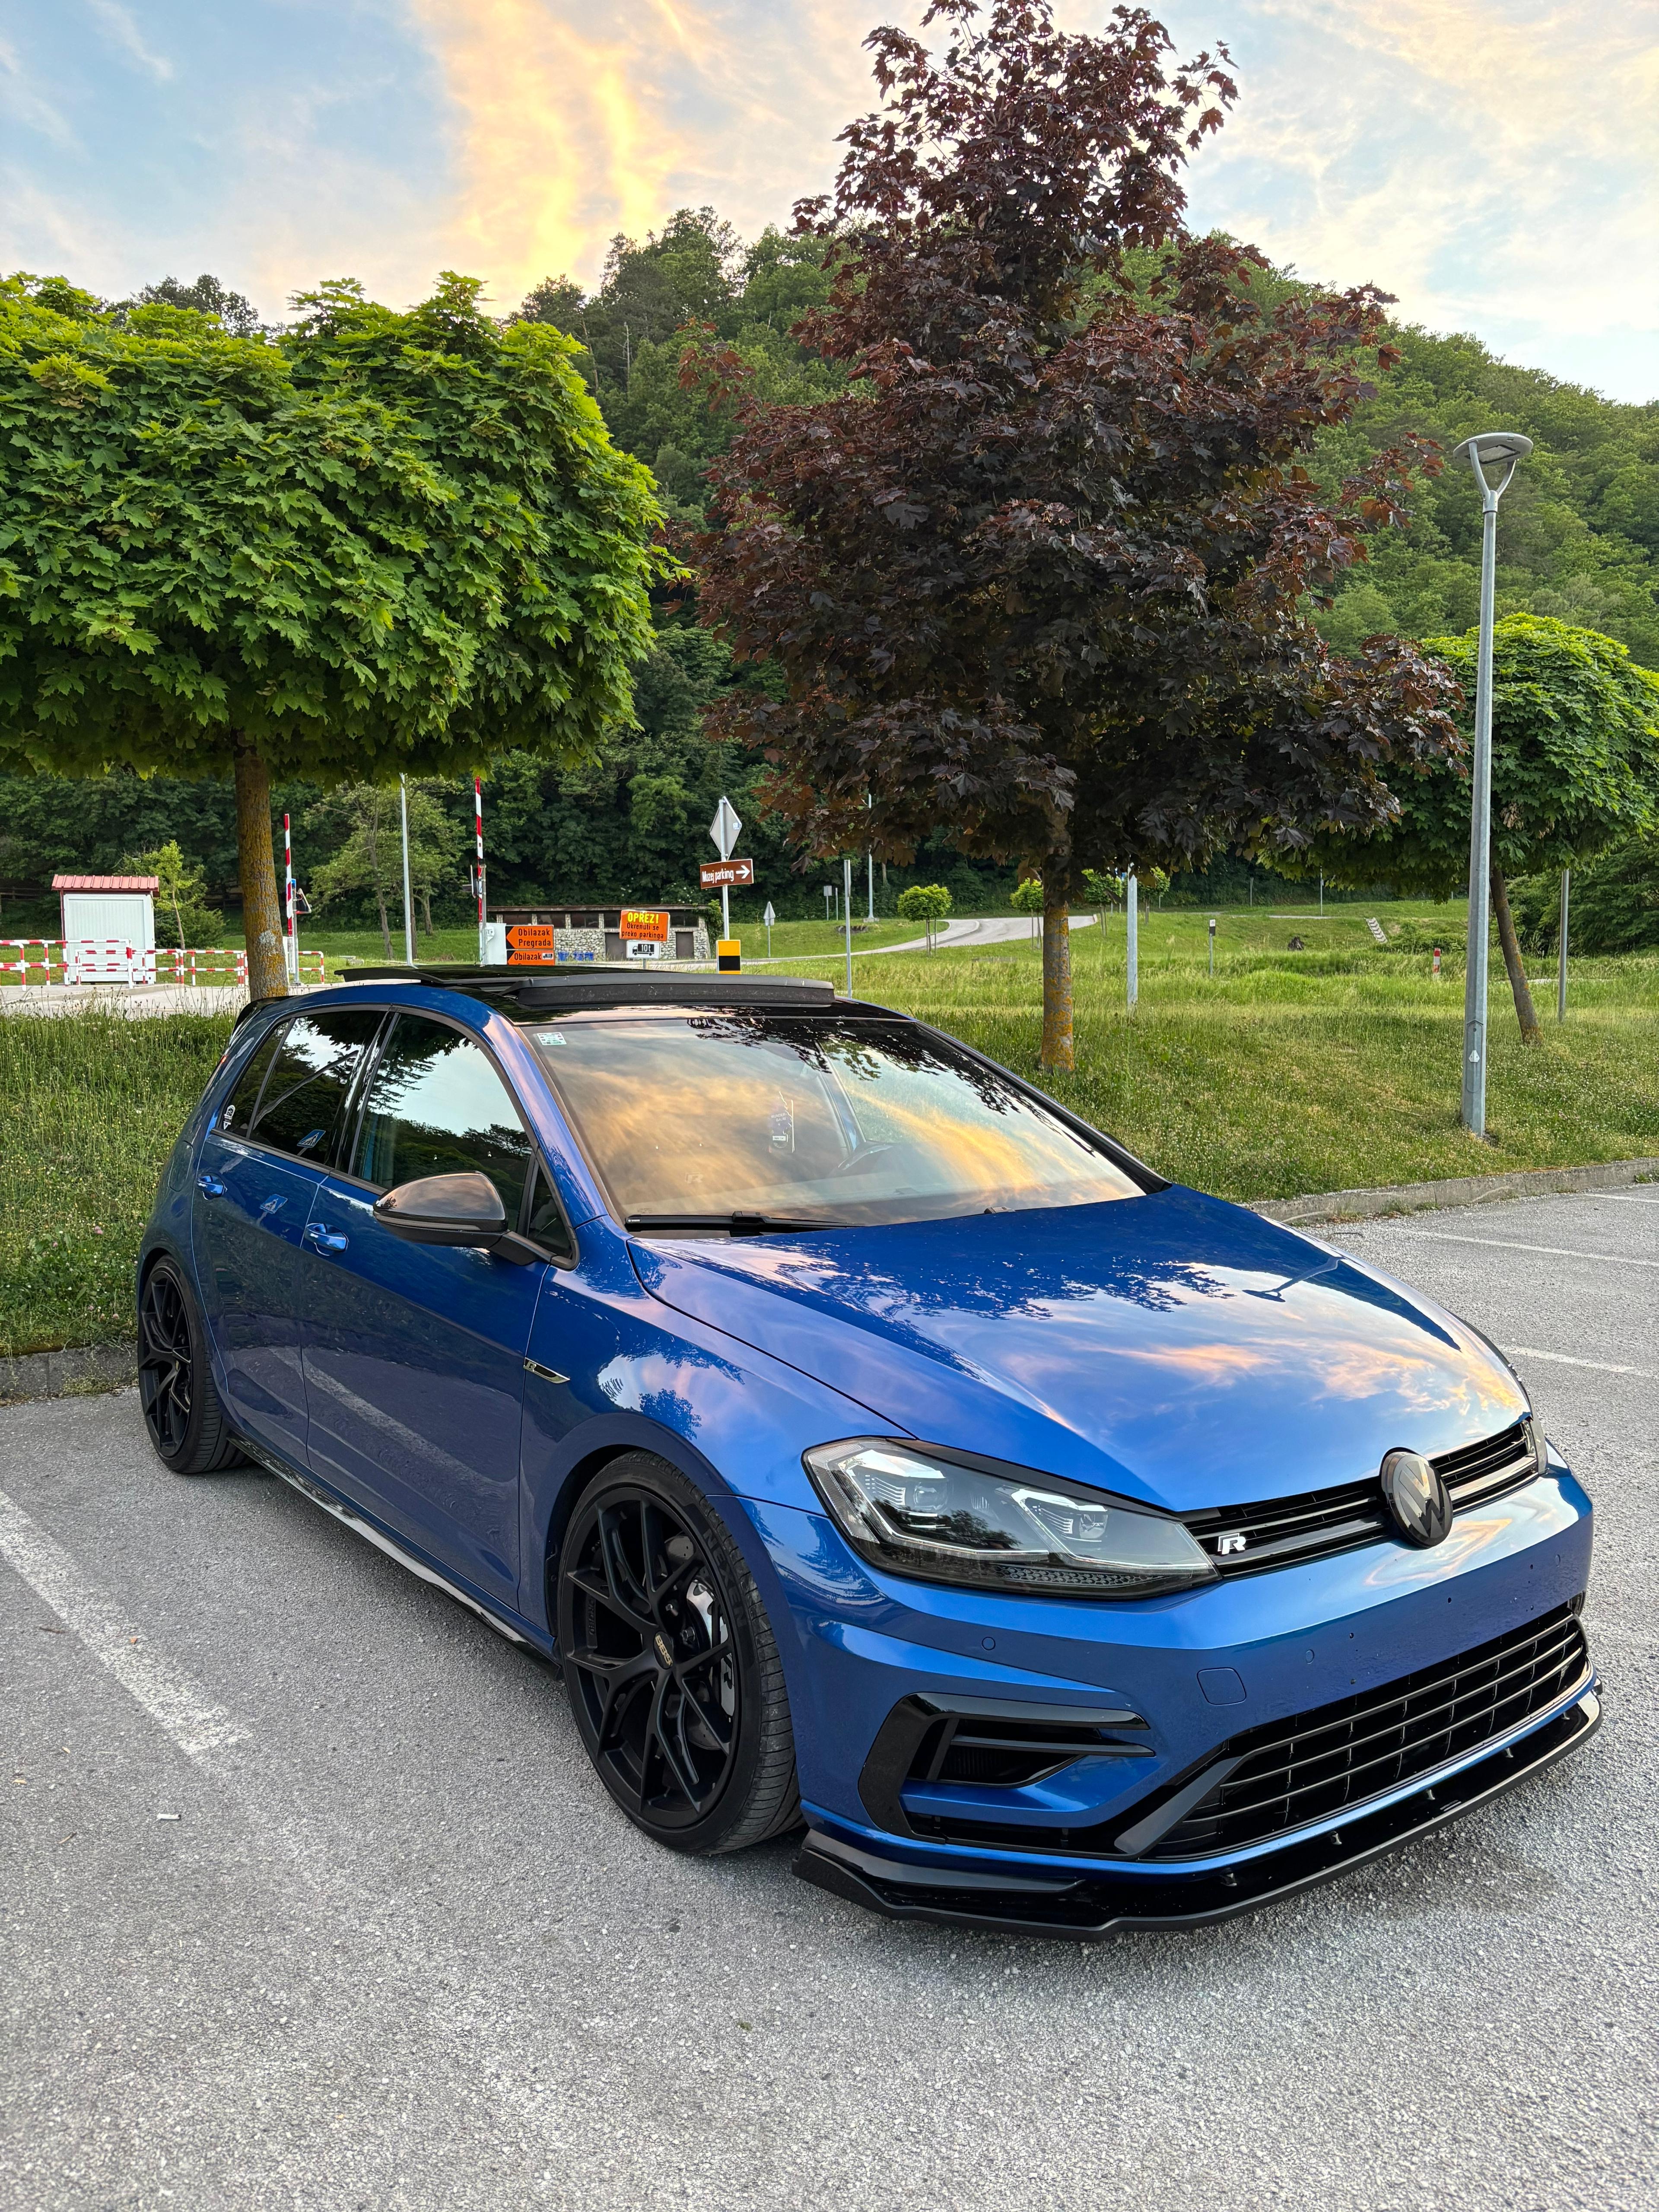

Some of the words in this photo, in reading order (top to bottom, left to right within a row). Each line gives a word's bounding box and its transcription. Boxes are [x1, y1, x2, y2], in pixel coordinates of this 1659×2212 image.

[702, 870, 714, 884] Muzej
[715, 868, 734, 884] parking
[518, 939, 551, 948] Pregrada
[1217, 1533, 1246, 1555] R
[703, 1528, 747, 1627] NEXEN
